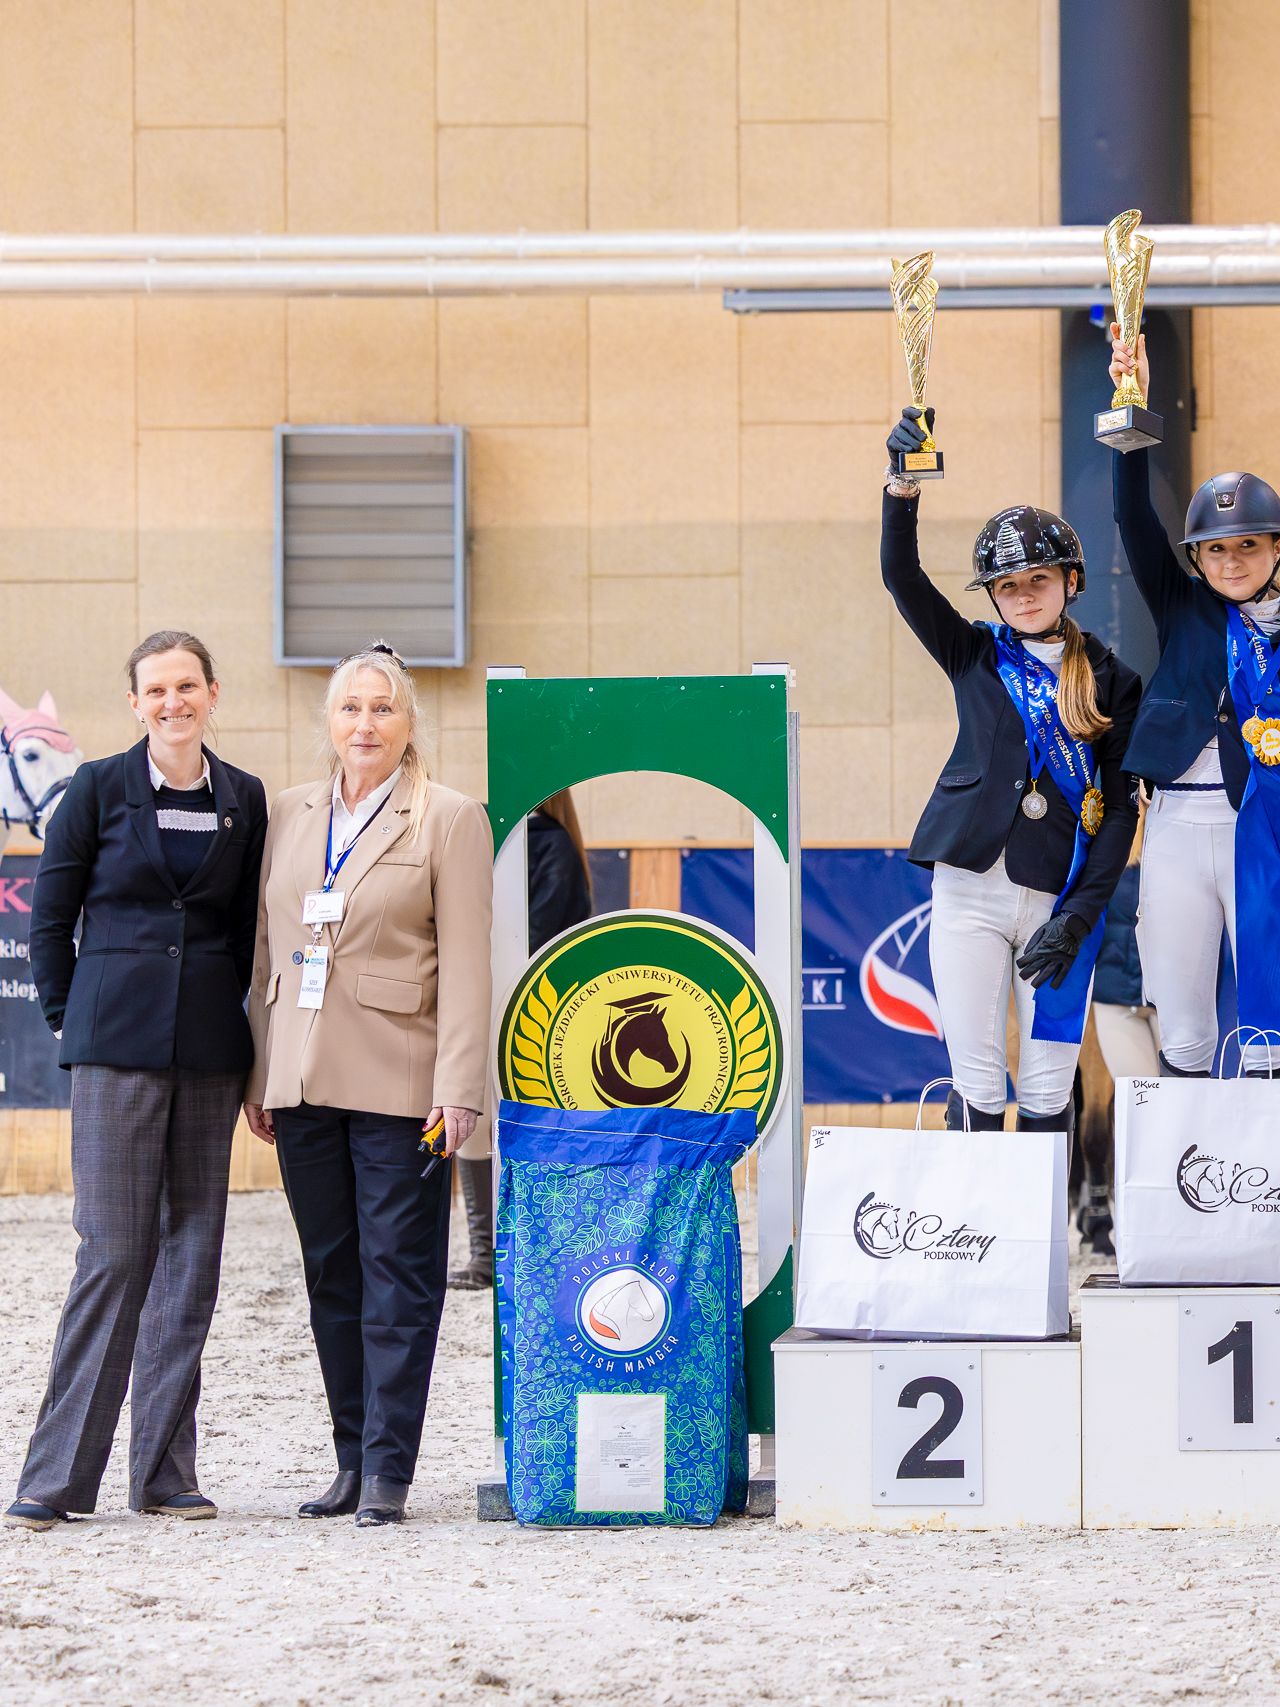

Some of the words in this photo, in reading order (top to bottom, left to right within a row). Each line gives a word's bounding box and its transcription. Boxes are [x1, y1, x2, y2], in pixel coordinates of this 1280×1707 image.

[607, 969, 704, 1003] UNIWERSYTETU
[554, 983, 601, 1049] JEŹDZIECKI
[553, 1052, 578, 1110] OŚRODEK
[900, 1211, 997, 1263] Cztery
[923, 1251, 976, 1261] PODKOWY
[572, 1250, 632, 1285] POLSKI
[640, 1253, 678, 1286] ŻŁÓB
[566, 1333, 614, 1372] POLISH
[624, 1335, 679, 1373] MANGER
[1207, 1320, 1254, 1424] 1
[896, 1375, 965, 1480] 2
